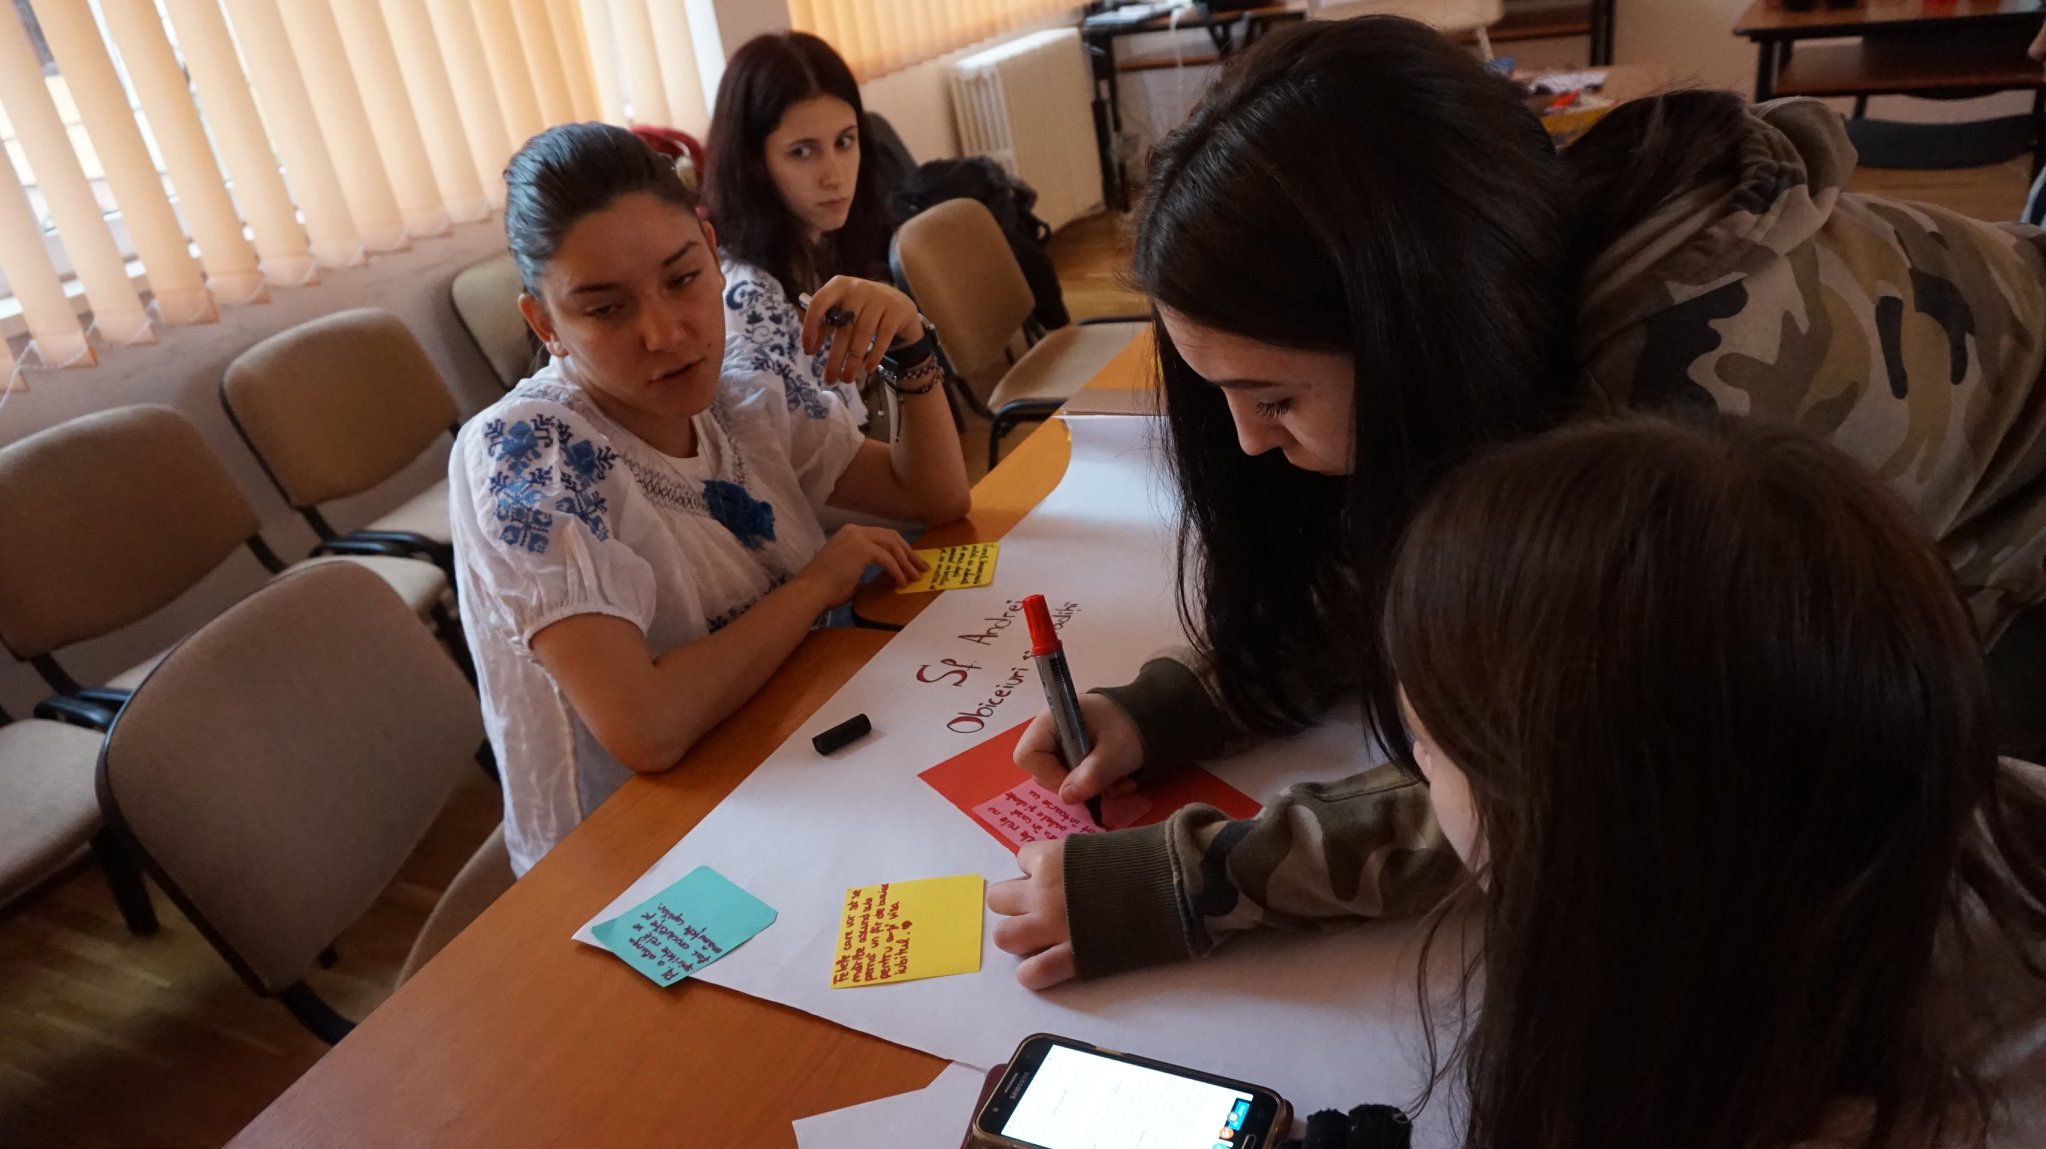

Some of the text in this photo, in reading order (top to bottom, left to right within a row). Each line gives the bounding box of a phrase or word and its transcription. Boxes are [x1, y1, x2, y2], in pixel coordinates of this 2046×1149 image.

[946, 666, 1030, 734] Obiceiuri
[843, 930, 853, 951] care
[870, 936, 879, 949] un
